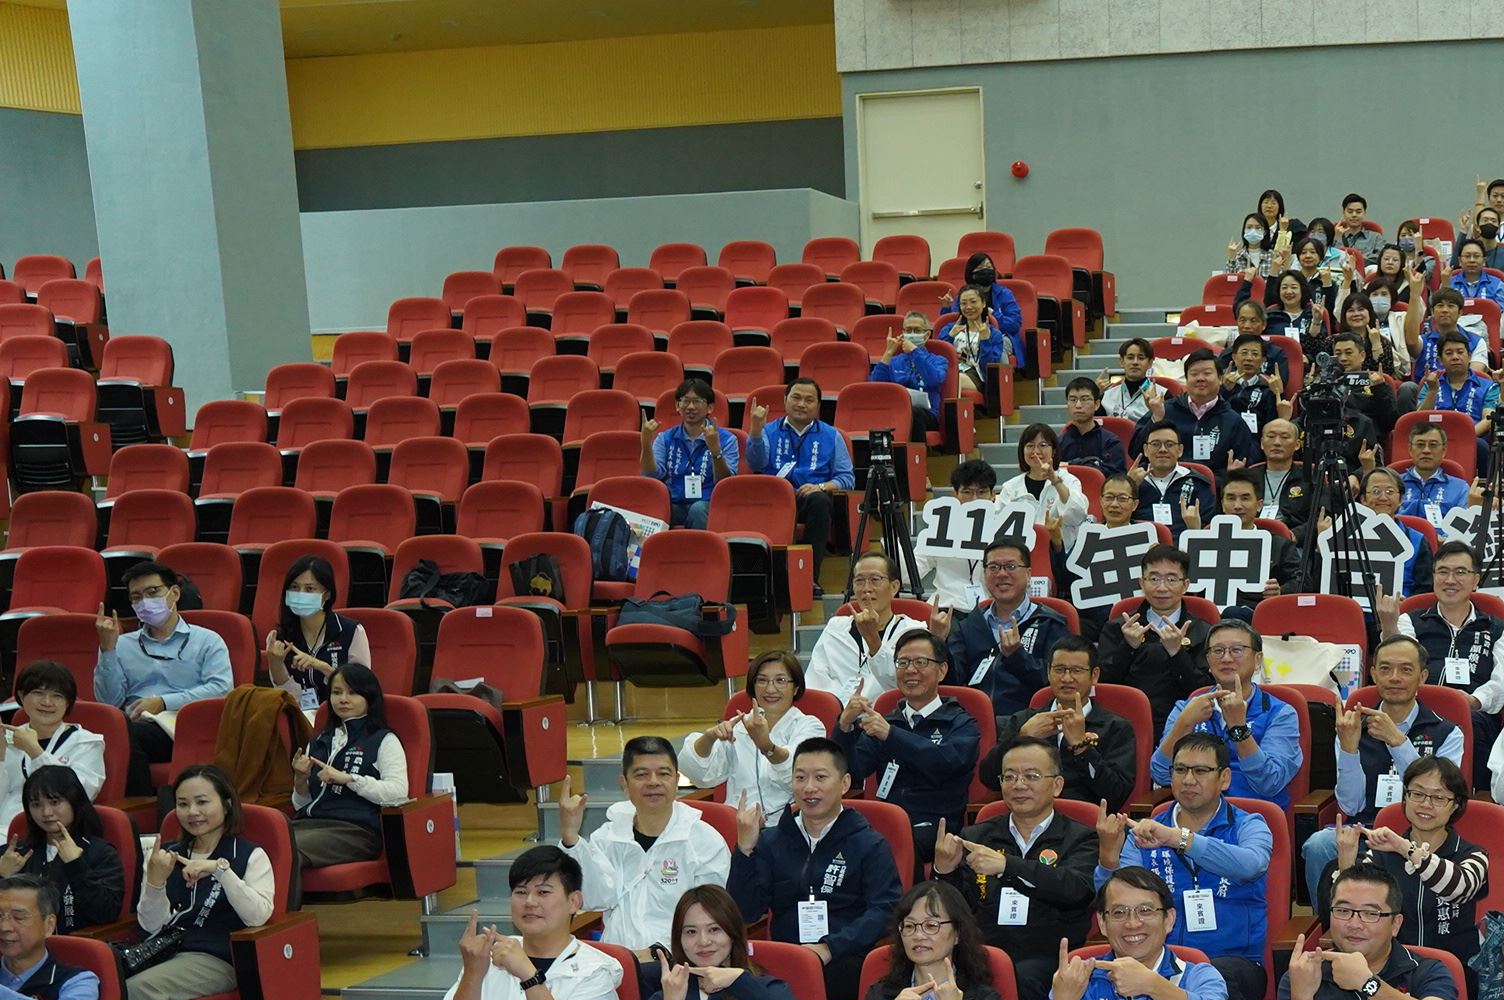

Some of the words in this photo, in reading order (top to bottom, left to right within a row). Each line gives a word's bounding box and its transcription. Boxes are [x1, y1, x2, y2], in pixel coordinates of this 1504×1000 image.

[926, 505, 1028, 550] 114
[1187, 523, 1263, 605] 中
[1328, 510, 1407, 600] 台
[1075, 531, 1152, 600] 年
